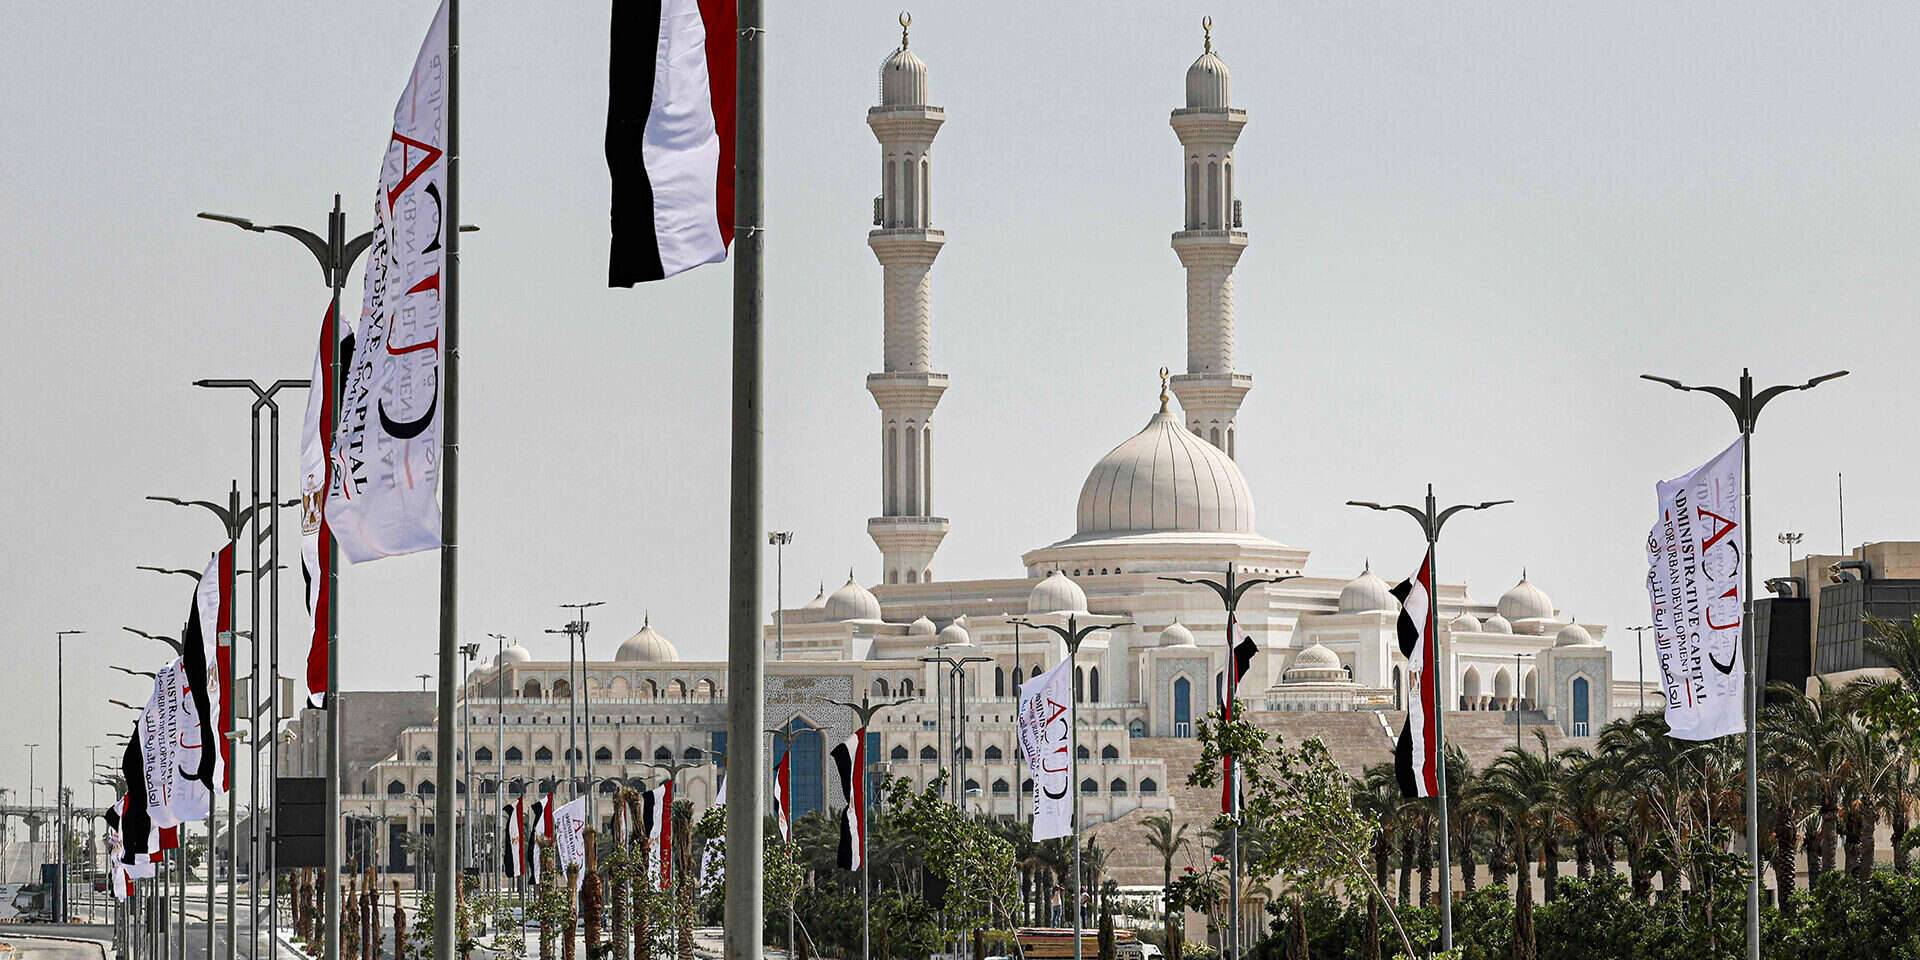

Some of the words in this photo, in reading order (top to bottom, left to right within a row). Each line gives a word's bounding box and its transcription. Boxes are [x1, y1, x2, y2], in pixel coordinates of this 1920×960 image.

[350, 360, 373, 495] CAPITAL
[1664, 521, 1676, 544] FOR
[1667, 544, 1680, 585] URBAN
[1671, 587, 1689, 673] DEVELOPMENT
[1662, 653, 1682, 709] العاصمة
[1690, 632, 1709, 705] CAPITAL
[166, 668, 177, 747] INISTRATIVE
